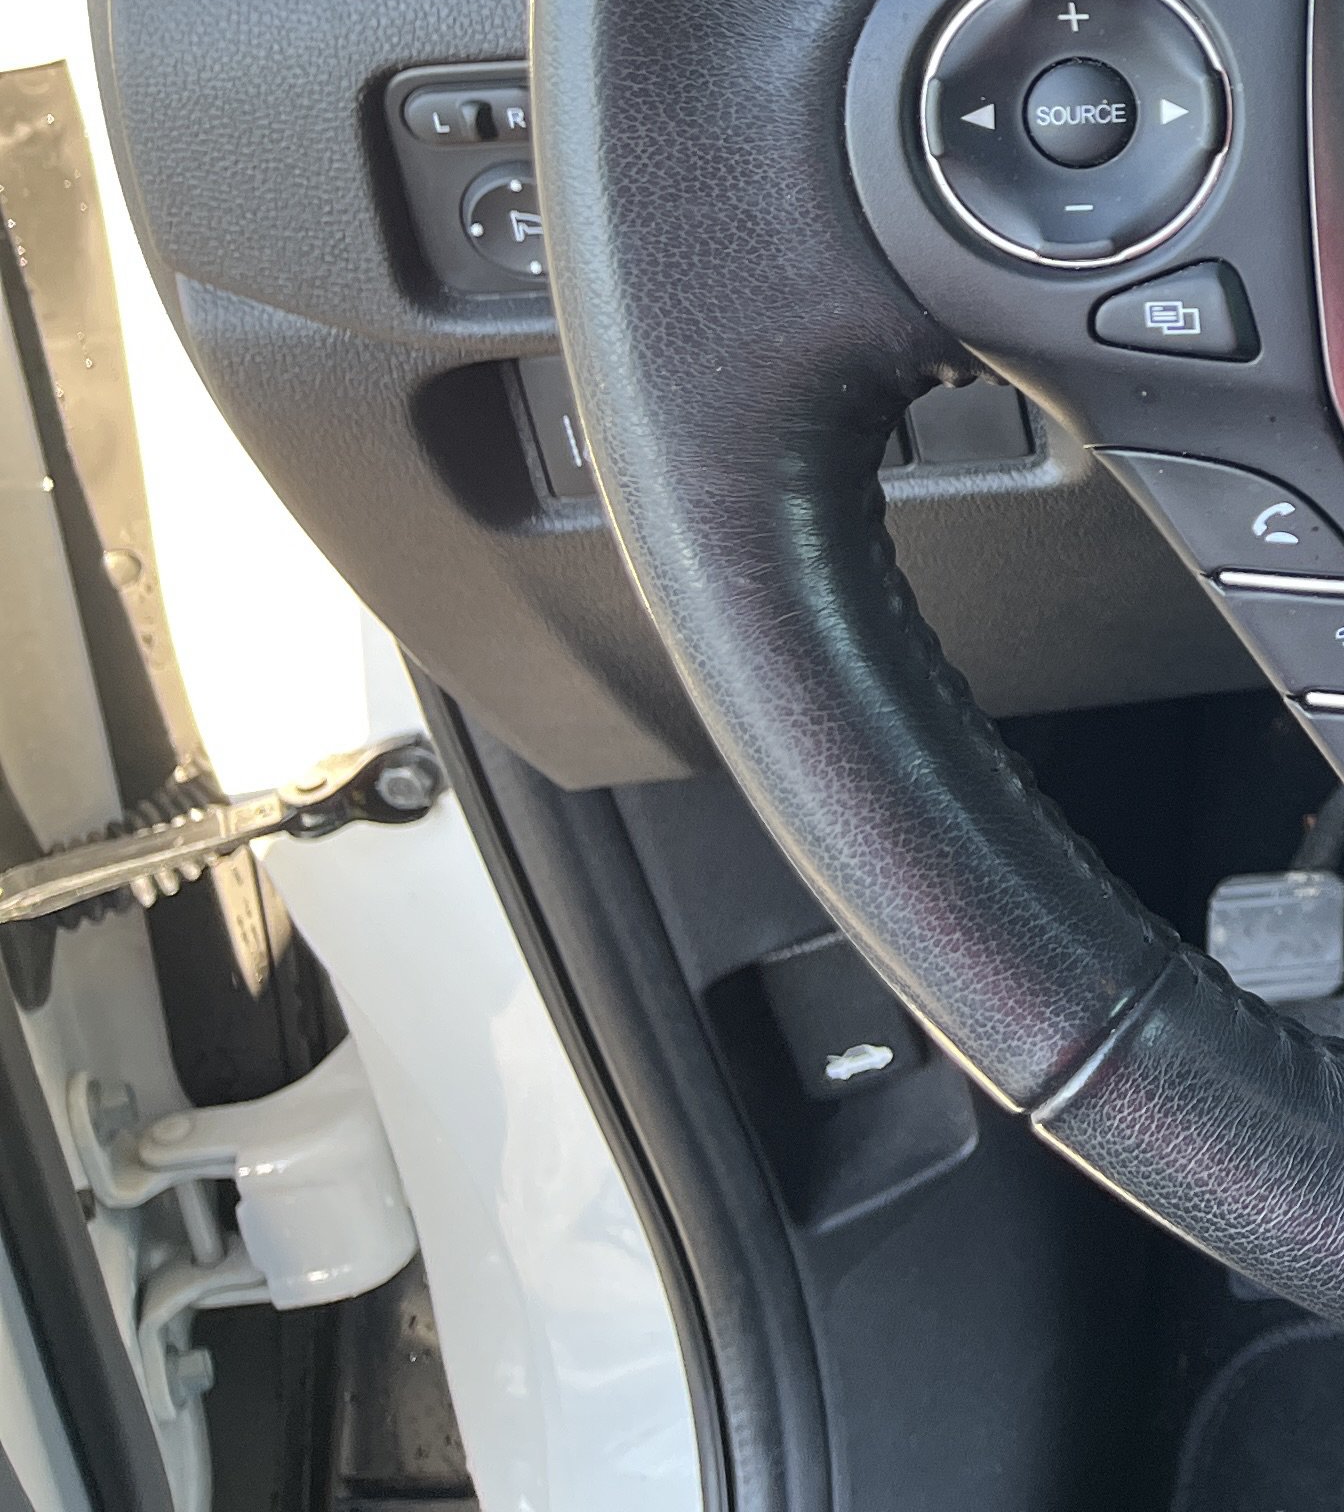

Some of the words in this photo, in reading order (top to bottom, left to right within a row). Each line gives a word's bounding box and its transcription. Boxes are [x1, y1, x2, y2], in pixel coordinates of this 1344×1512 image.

[431, 111, 452, 134] L
[505, 106, 528, 130] R
[1035, 103, 1128, 126] SOURCE
